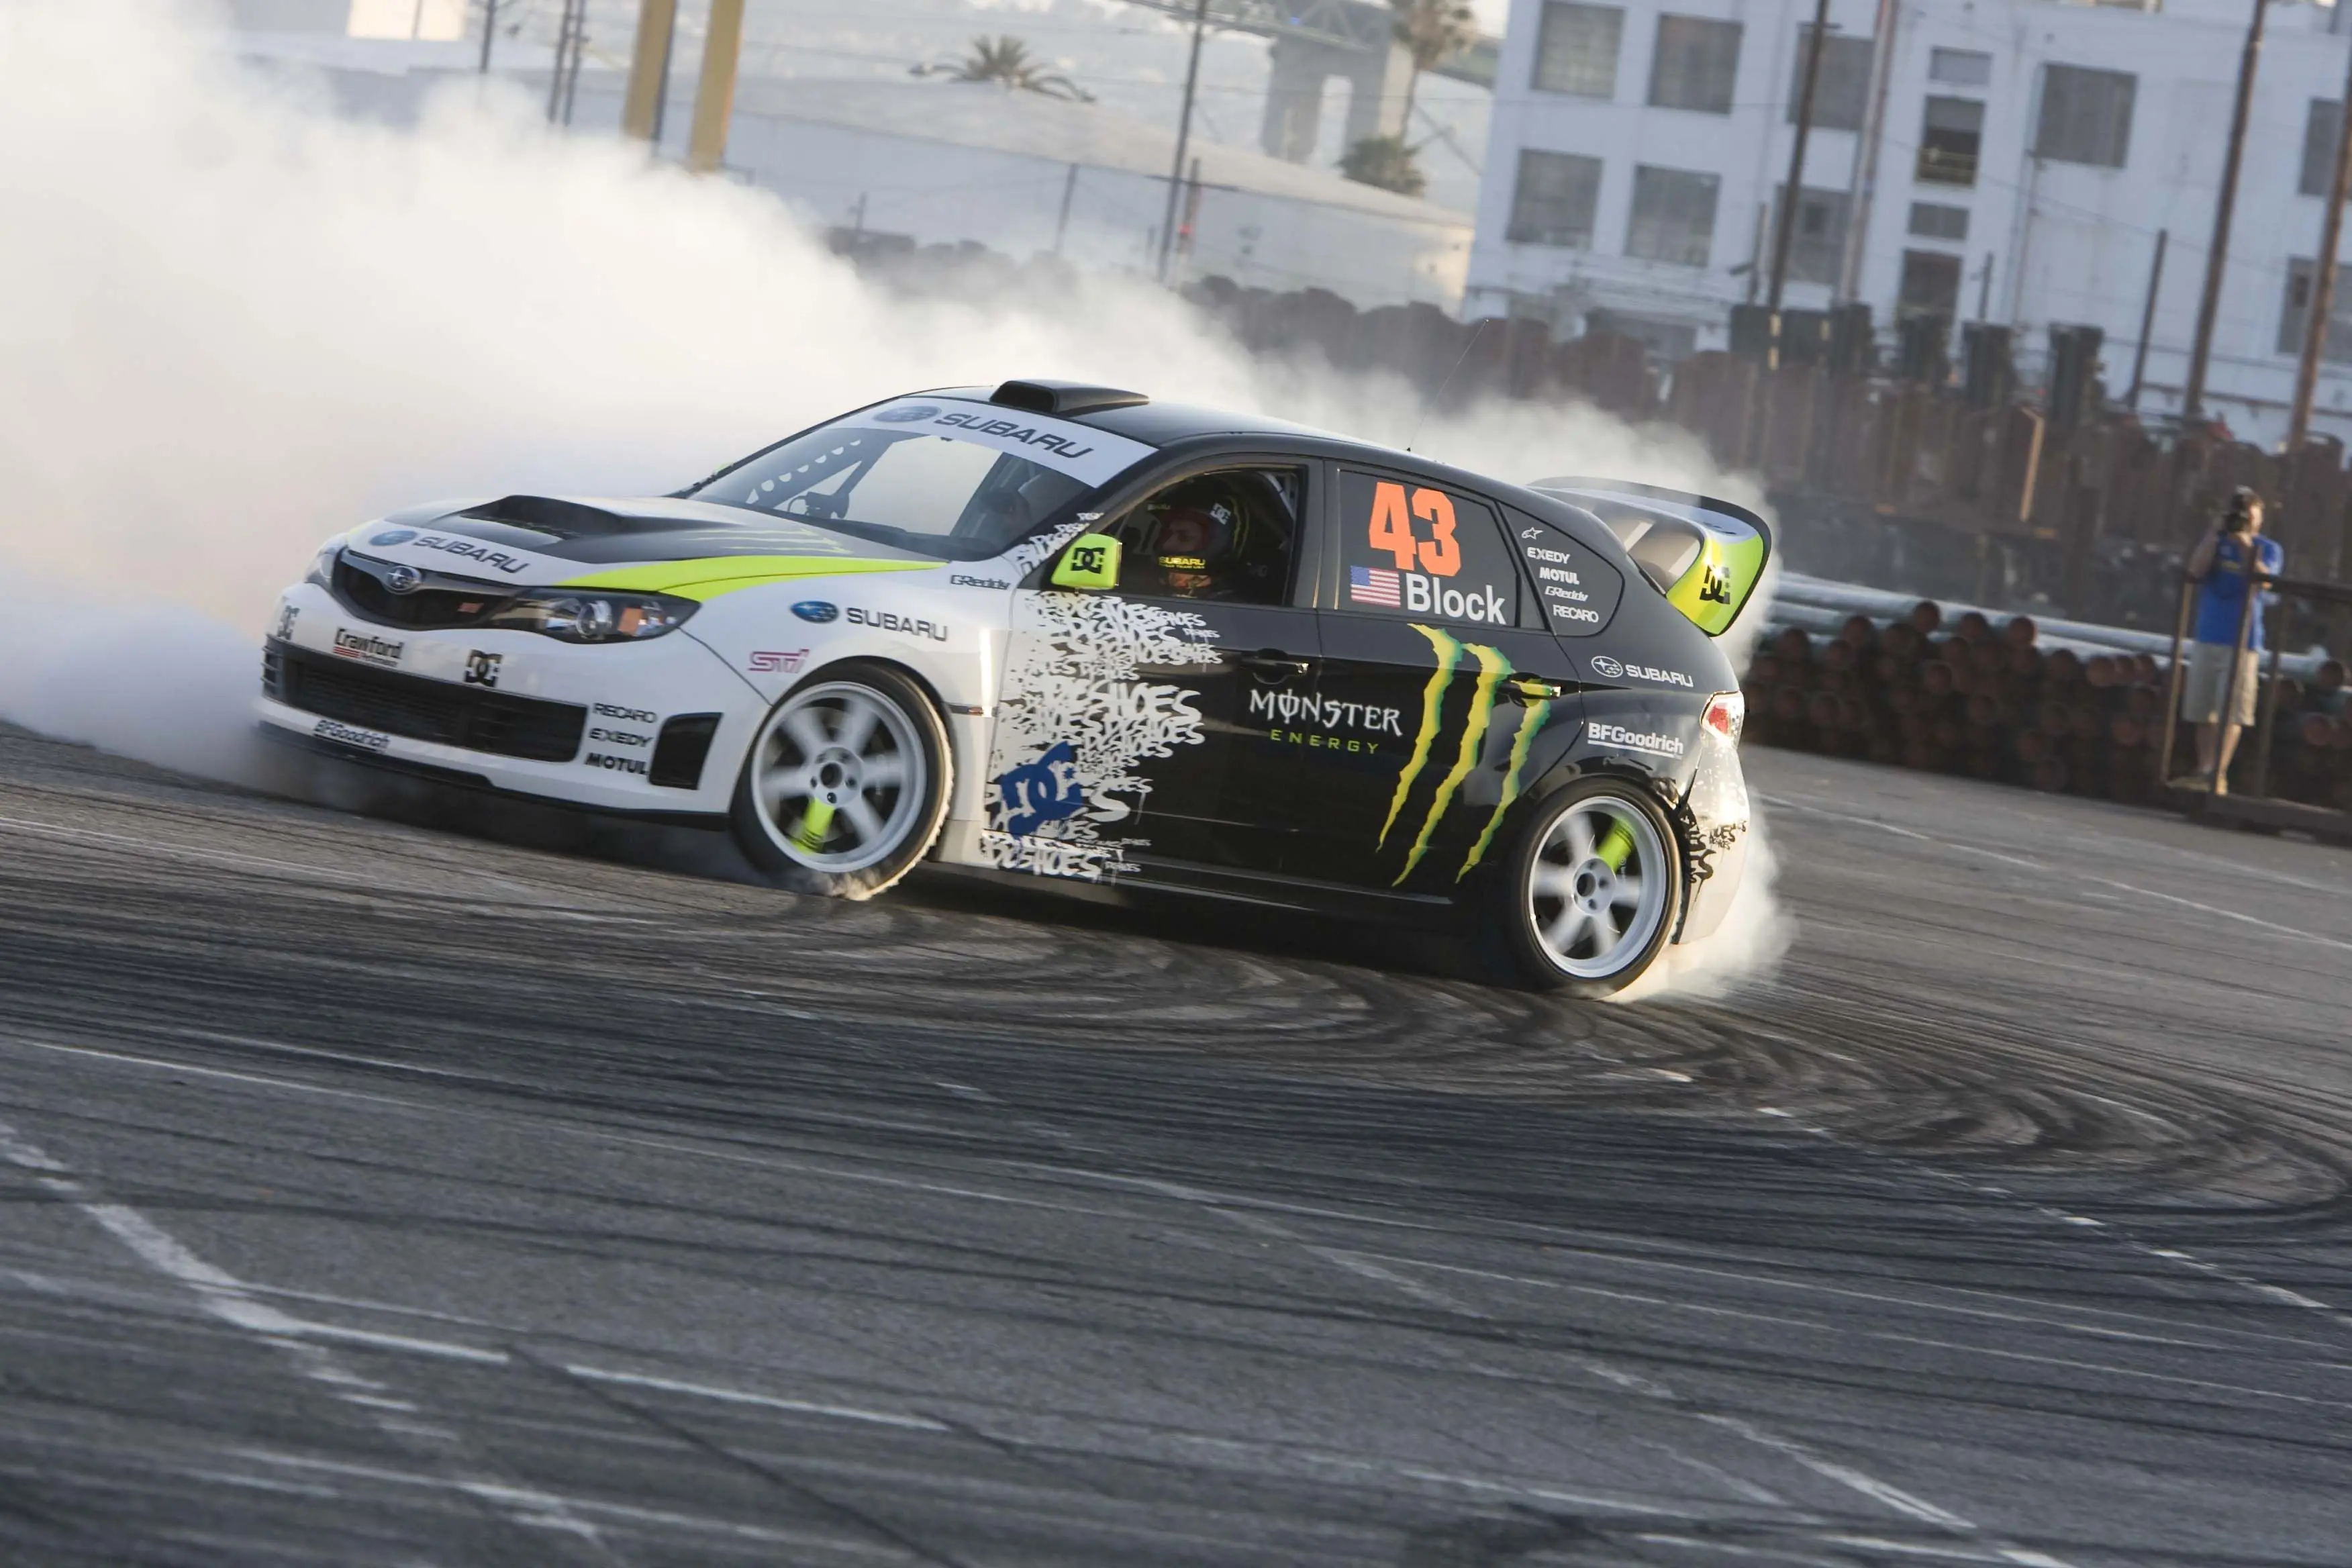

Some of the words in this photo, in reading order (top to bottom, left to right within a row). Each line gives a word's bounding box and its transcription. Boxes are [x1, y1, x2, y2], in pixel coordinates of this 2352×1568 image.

[934, 413, 1094, 459] SUBARU
[1368, 481, 1461, 577] 43
[413, 536, 530, 575] SUBARU
[1159, 556, 1206, 566] SUBARU
[1527, 546, 1571, 564] EXEDY
[1539, 567, 1580, 585] MOTUL
[1406, 573, 1508, 626] Block
[845, 607, 948, 642] SUBARU
[1553, 604, 1599, 624] RECARO
[335, 628, 405, 659] Crawford
[1626, 664, 1694, 688] SUBARU
[593, 702, 657, 724] RECARO
[1249, 688, 1404, 737] MONSTER
[315, 720, 391, 749] BFGoodrich
[589, 728, 654, 748] EXEDY
[1270, 728, 1379, 754] ENERGY
[1588, 723, 1684, 755] BFGoodrich
[584, 752, 650, 775] MOTUL
